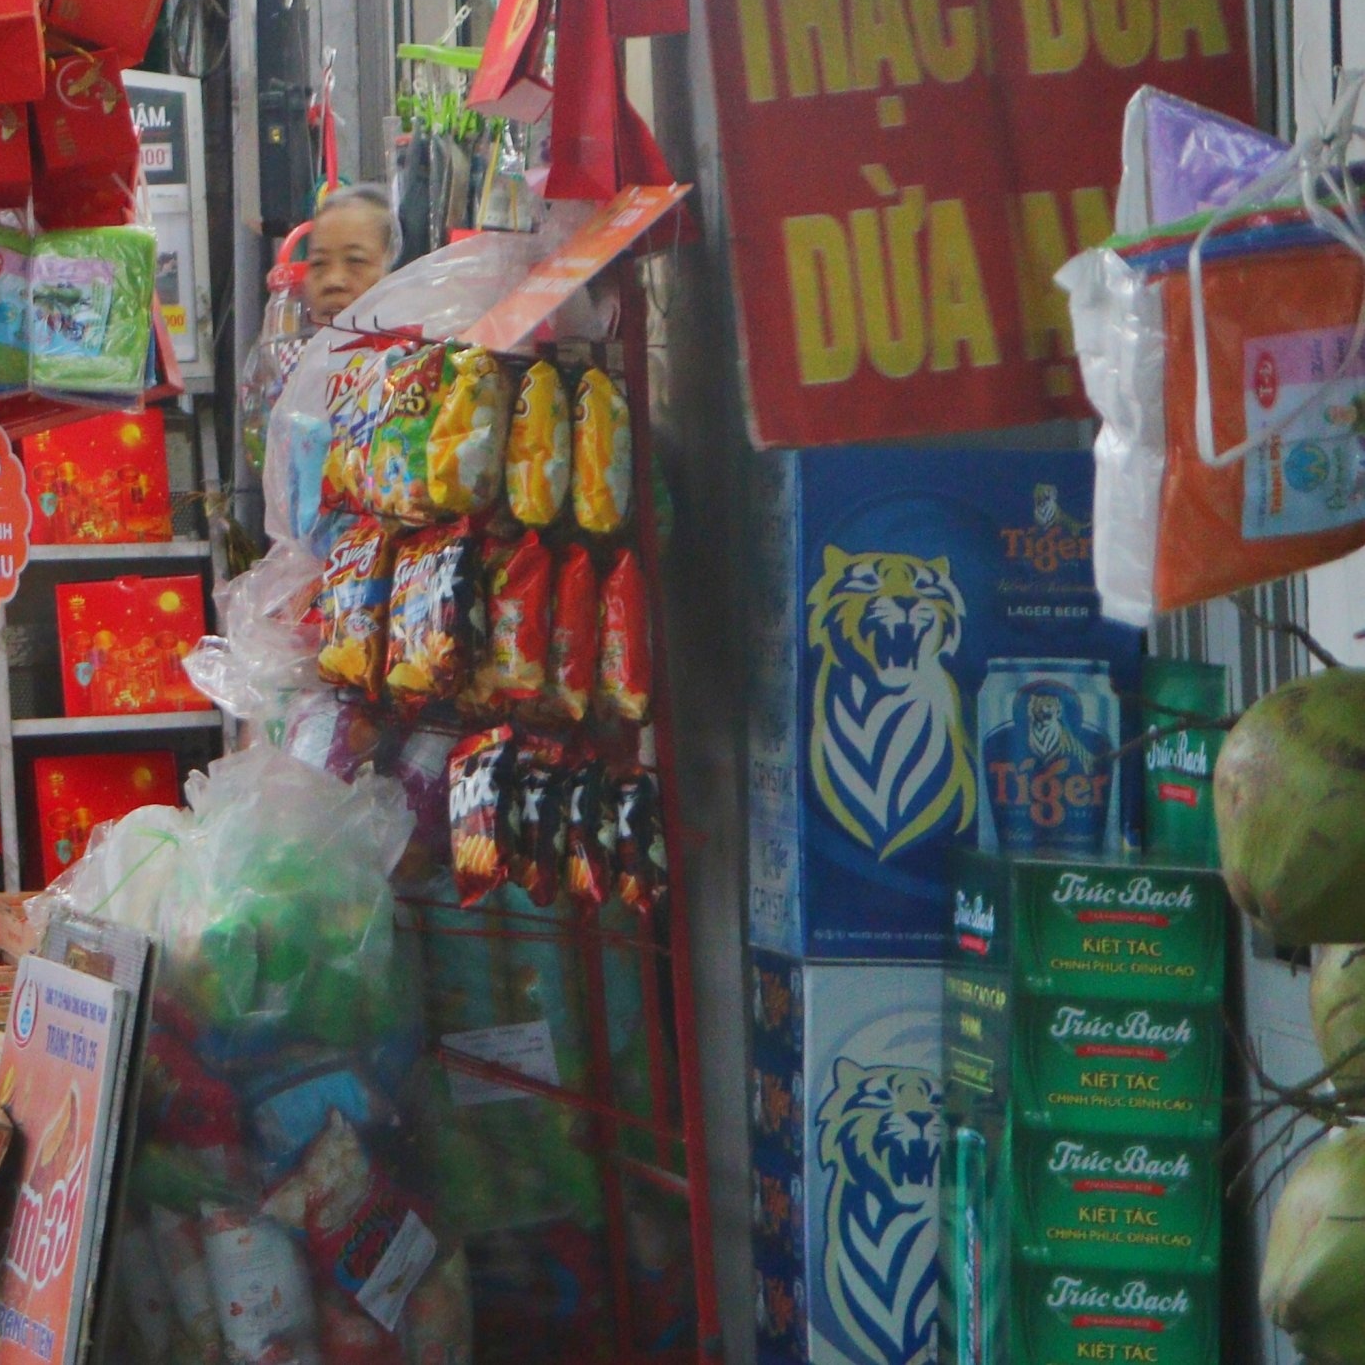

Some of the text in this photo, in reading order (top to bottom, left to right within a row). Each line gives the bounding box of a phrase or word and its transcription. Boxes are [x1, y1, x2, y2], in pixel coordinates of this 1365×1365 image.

[784, 163, 1002, 385] DỪA
[1007, 605, 1089, 618] LAGER BEER
[989, 757, 1110, 828] Tiger
[1052, 872, 1194, 911] Trúc Bạch
[1127, 938, 1162, 958] TÁC
[1050, 1006, 1193, 1043] Trúc Bạch
[1125, 1073, 1160, 1091] TÁC
[1048, 1141, 1190, 1179] Trúc Bạch
[1123, 1207, 1159, 1226] TÁC
[1047, 1276, 1189, 1314] Trúc Bạch
[1121, 1342, 1158, 1363] TÁC
